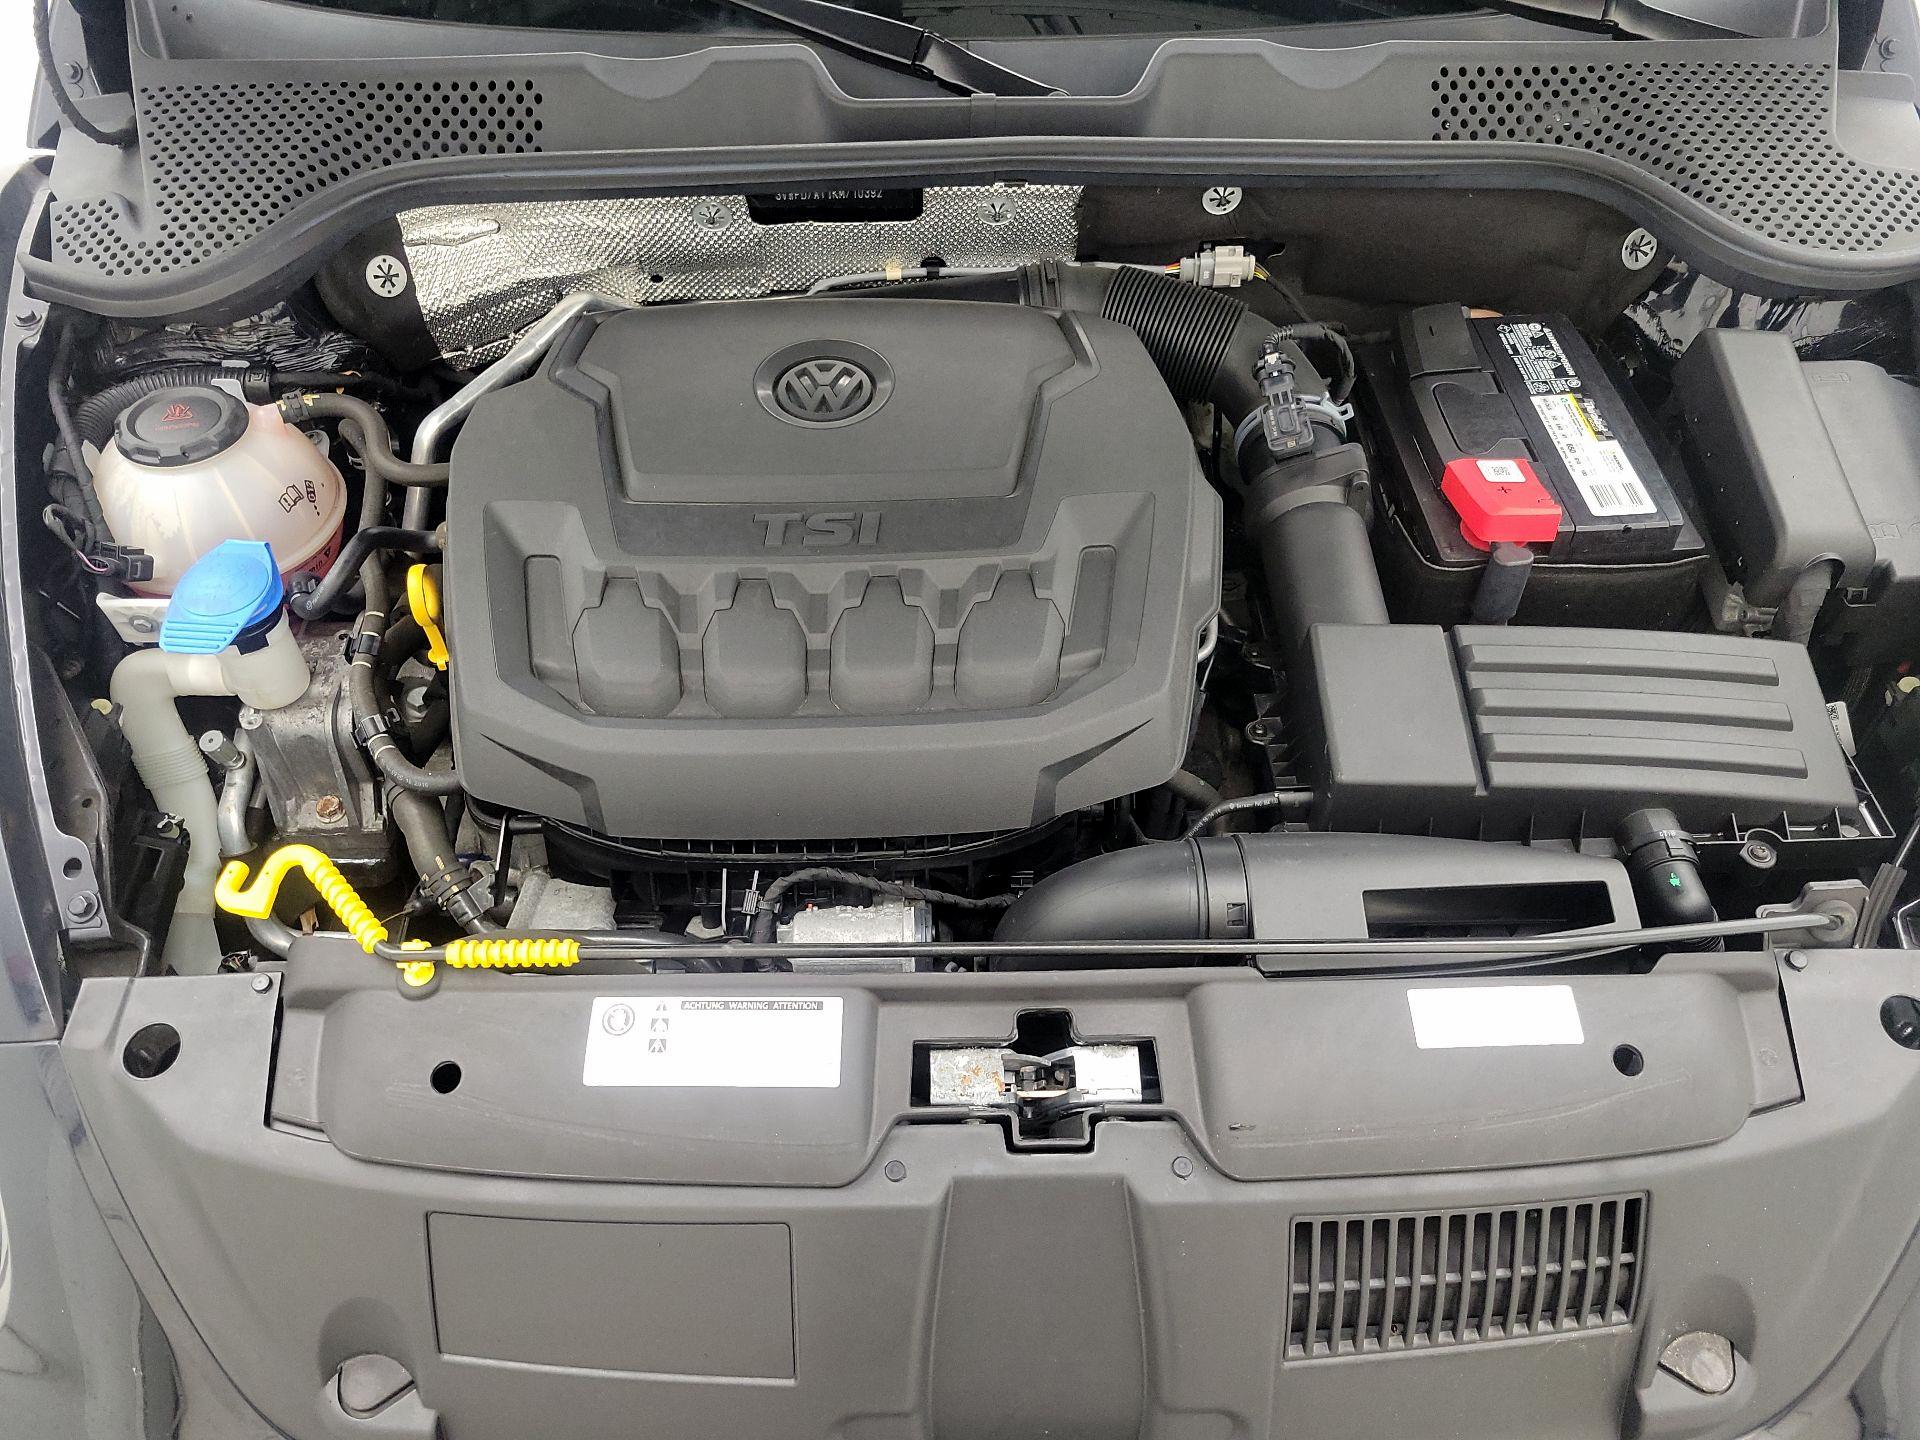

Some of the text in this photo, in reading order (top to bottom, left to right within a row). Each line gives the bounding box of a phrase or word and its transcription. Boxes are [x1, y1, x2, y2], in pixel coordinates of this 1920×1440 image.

[778, 359, 872, 421] VW
[752, 511, 882, 546] TSI
[683, 1001, 819, 1010] ACHTUNG WARNING ATTENTION
